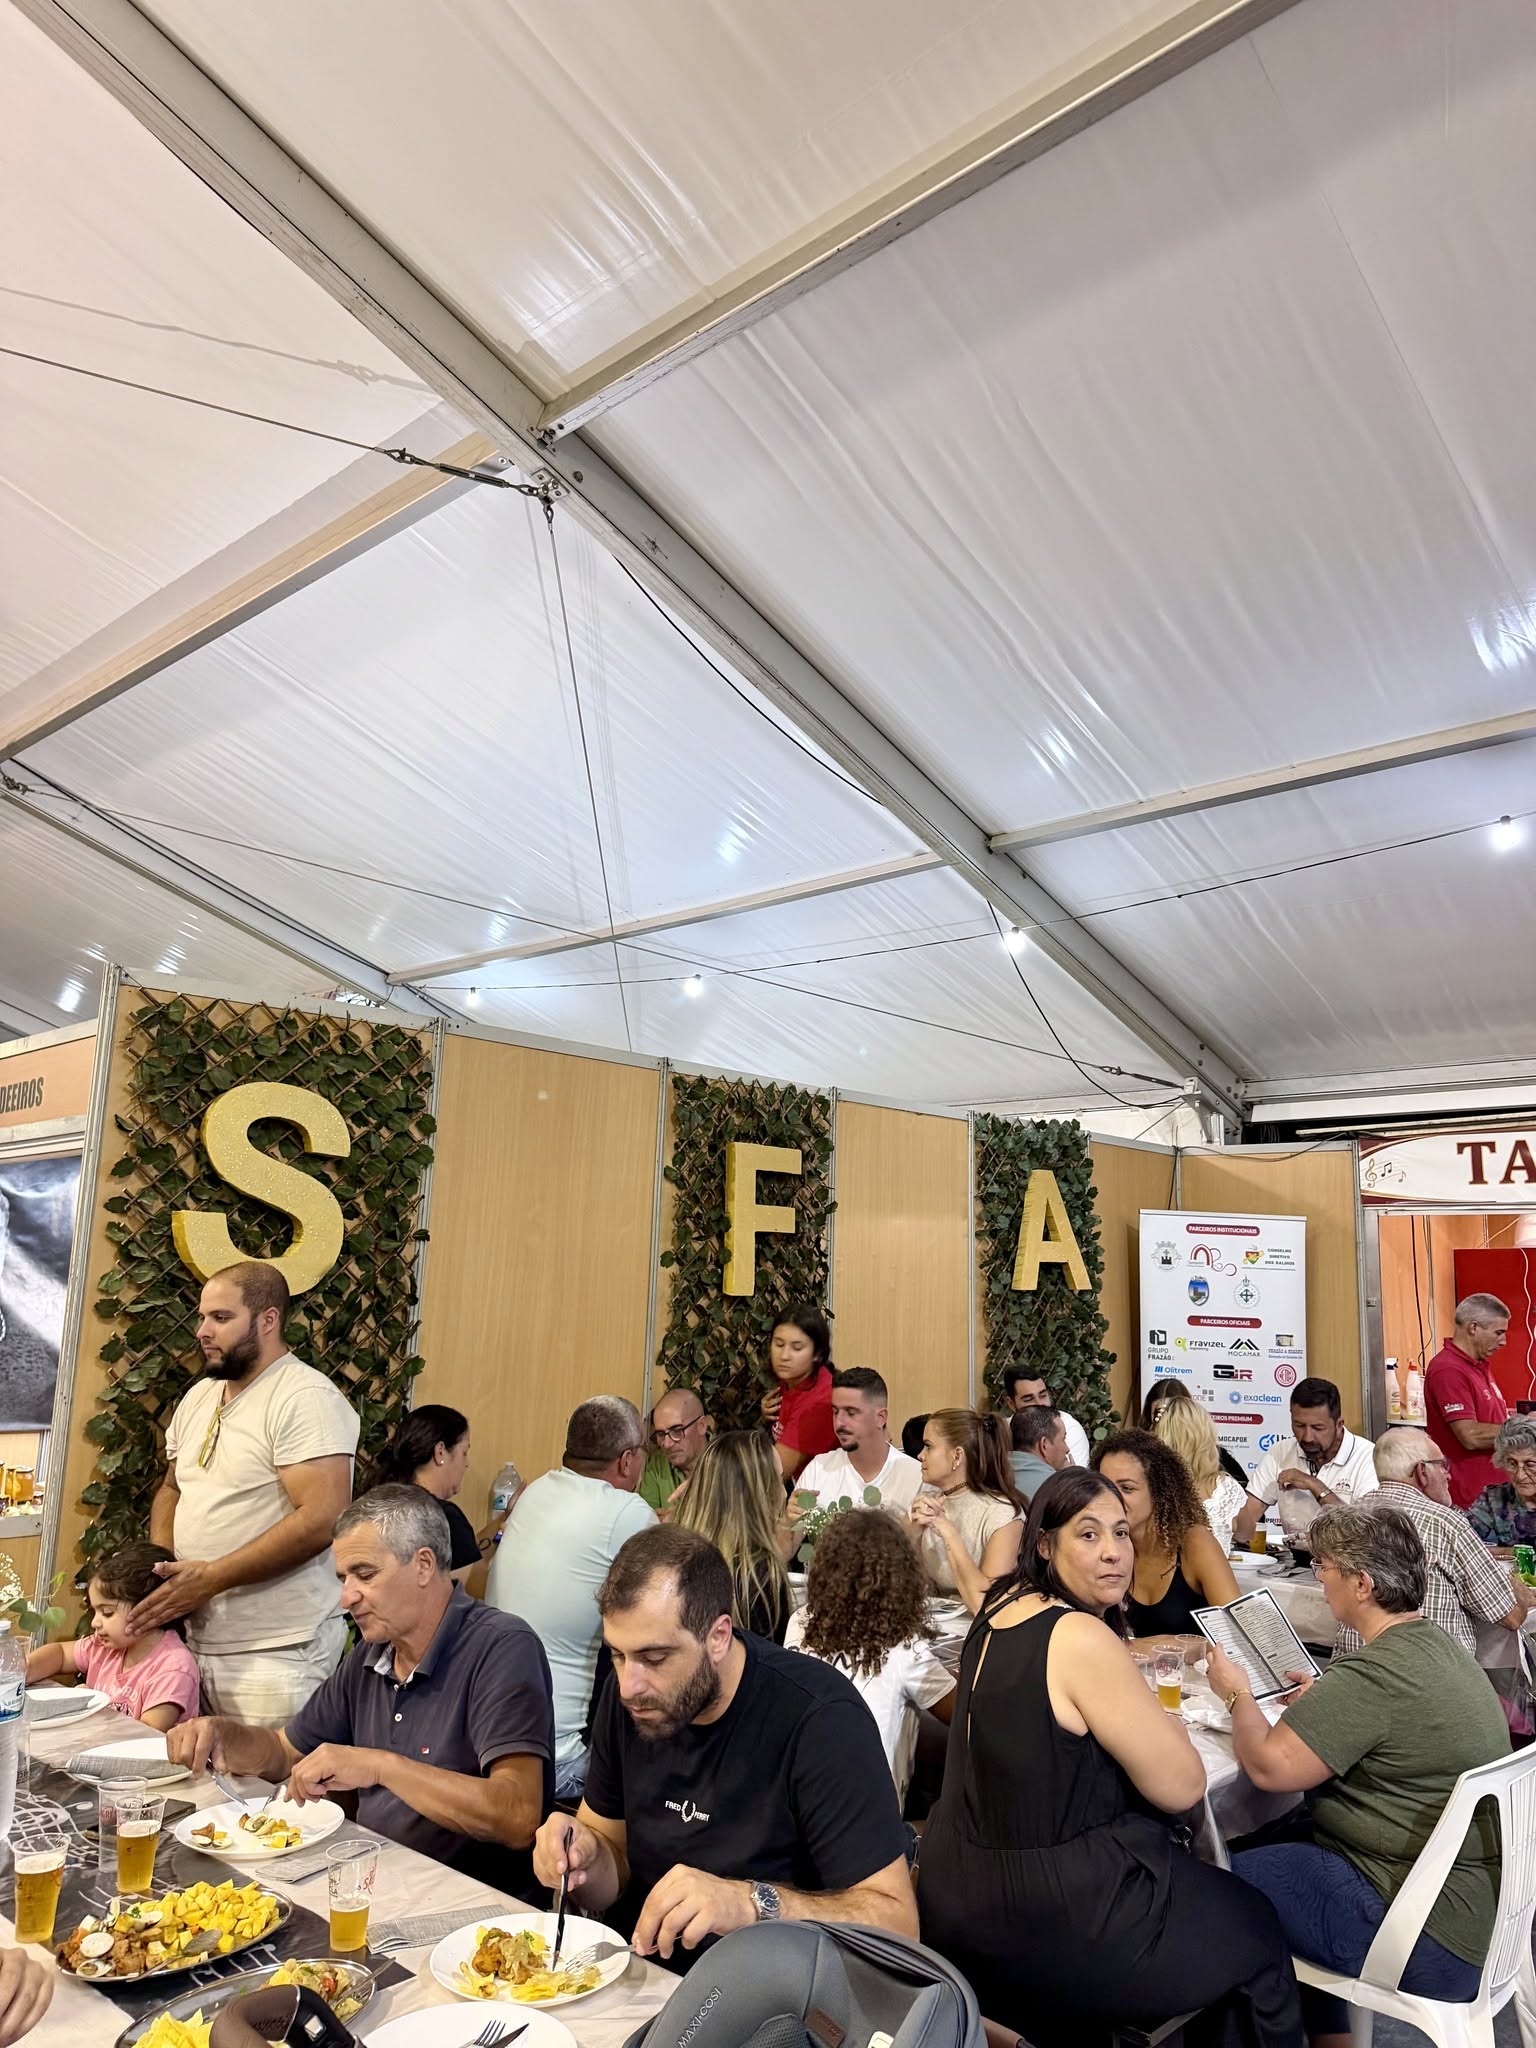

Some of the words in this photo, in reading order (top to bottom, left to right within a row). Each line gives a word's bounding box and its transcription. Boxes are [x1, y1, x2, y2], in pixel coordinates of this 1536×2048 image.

[723, 1142, 802, 1296] F
[1012, 1169, 1092, 1291] A
[1164, 1366, 1193, 1374] Olitrem
[1243, 1393, 1282, 1402] exaclean
[665, 1800, 681, 1812] FRED
[694, 1811, 710, 1822] PERRY
